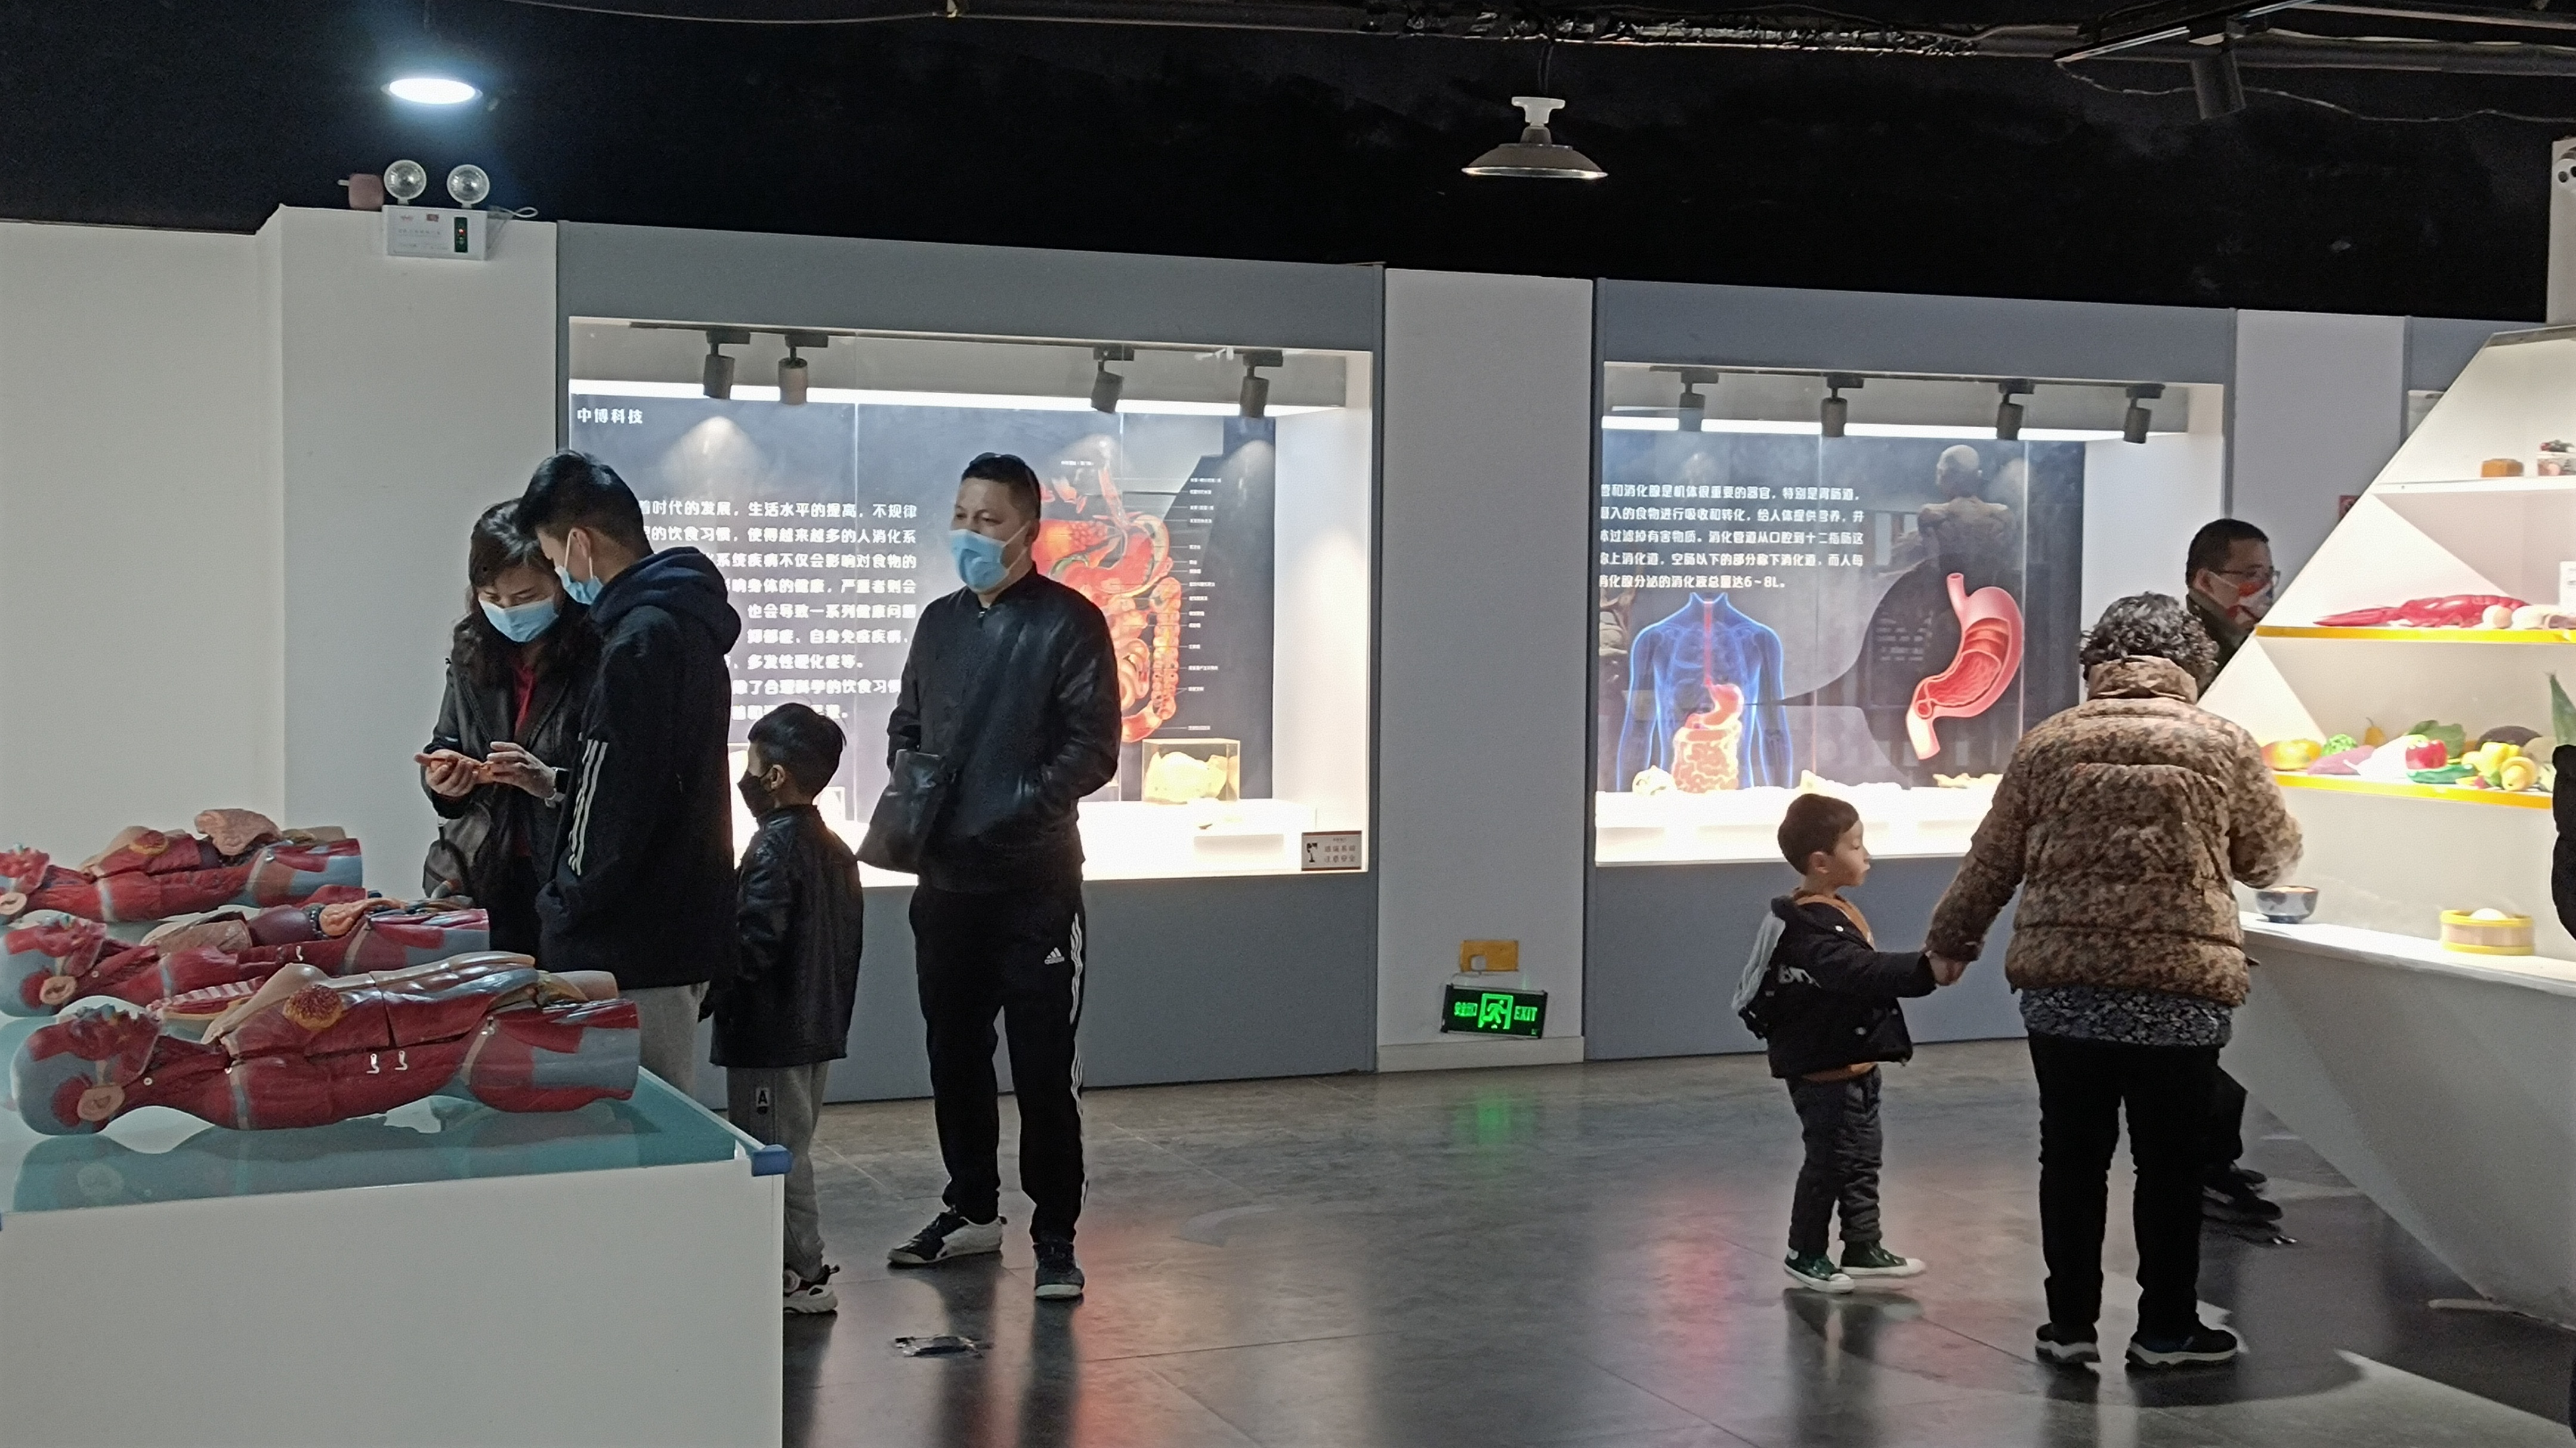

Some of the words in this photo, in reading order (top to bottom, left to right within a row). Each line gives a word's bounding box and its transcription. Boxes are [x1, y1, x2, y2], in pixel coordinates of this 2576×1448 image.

[576, 407, 643, 424] 中博科技
[1514, 1006, 1538, 1021] EXIT
[758, 1090, 768, 1104] A
